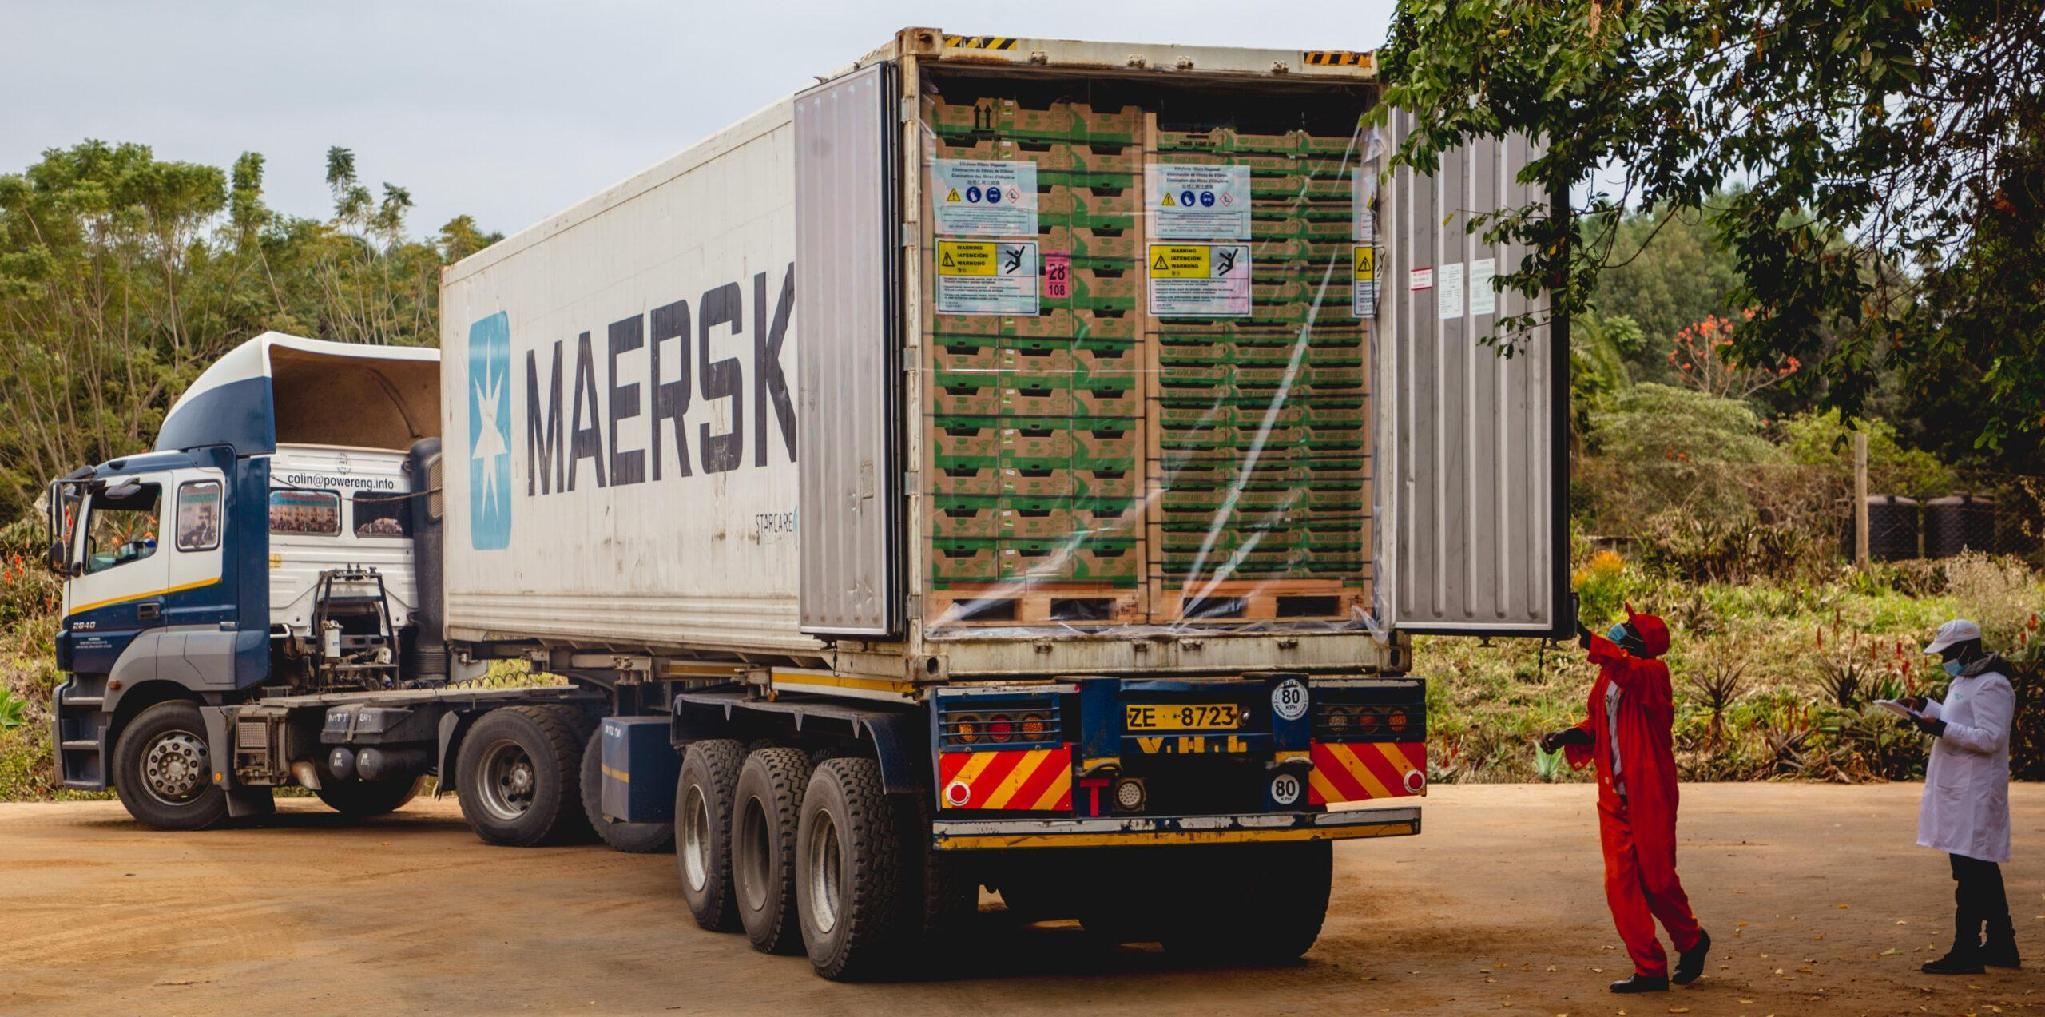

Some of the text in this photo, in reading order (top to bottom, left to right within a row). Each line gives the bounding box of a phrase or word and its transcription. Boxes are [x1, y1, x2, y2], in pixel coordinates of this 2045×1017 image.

[1049, 263, 1065, 281] 28
[1049, 284, 1066, 296] 108
[526, 261, 796, 497] MAERSK
[287, 473, 394, 491] colin@powereng.info
[1282, 689, 1300, 704] 80
[1129, 706, 1234, 727] ZE 8723
[1080, 778, 1110, 817] T
[1276, 780, 1296, 797] 80
